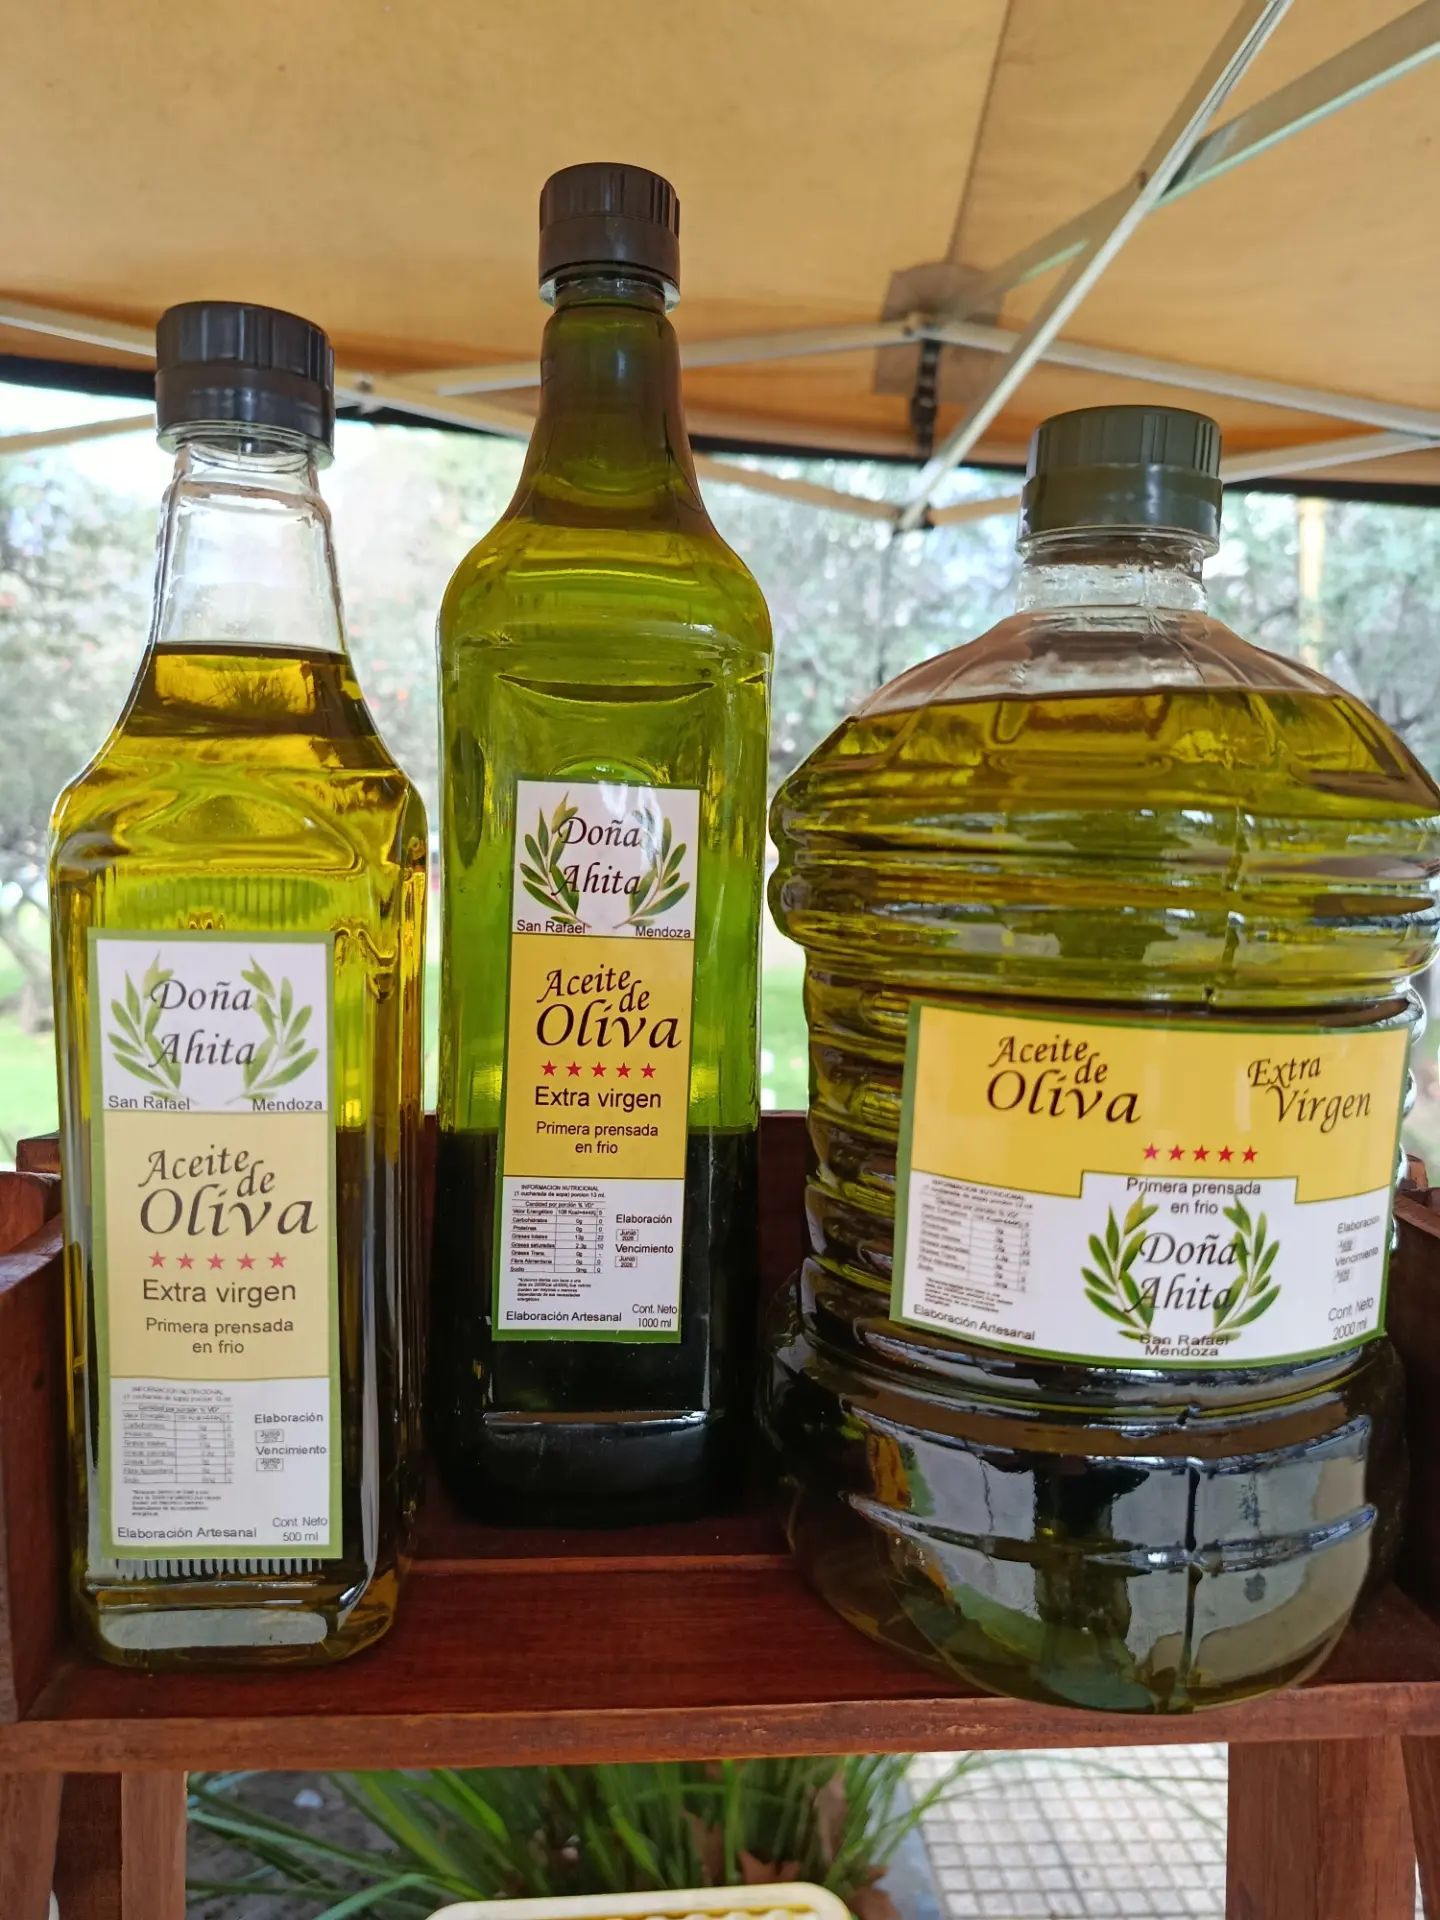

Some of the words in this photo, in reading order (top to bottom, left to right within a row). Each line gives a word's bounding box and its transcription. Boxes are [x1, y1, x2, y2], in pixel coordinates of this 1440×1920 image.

[557, 816, 641, 847] Doña
[551, 862, 642, 896] Ahita
[517, 919, 541, 932] San
[545, 921, 586, 934] Rafael
[635, 925, 691, 938] Mendoza
[536, 964, 631, 1003] Aceite
[150, 979, 252, 1011] Doña
[619, 980, 650, 1013] de
[536, 999, 682, 1049] Oliva
[148, 1029, 256, 1068] Ahita
[988, 1034, 1089, 1069] Aceite
[1074, 1052, 1108, 1085] de
[1247, 1056, 1321, 1089] Extra
[108, 1095, 138, 1109] San
[143, 1096, 190, 1110] Rafael
[252, 1098, 323, 1111] Mendoza
[535, 1086, 590, 1107] Extra
[597, 1089, 662, 1112] virgen
[987, 1068, 1142, 1124] Oliva
[1265, 1085, 1371, 1134] Virgen
[536, 1121, 590, 1135] Primera
[594, 1123, 658, 1138] prensada
[575, 1143, 592, 1154] en
[597, 1141, 618, 1154] frio
[137, 1144, 251, 1187] Aceite
[236, 1160, 275, 1198] de
[1126, 1177, 1188, 1194] Primera
[1192, 1178, 1261, 1197] prensada
[140, 1183, 318, 1236] Oliva
[1170, 1202, 1189, 1214] en
[1194, 1200, 1218, 1215] frio
[616, 1214, 672, 1224] Elaboración
[615, 1243, 674, 1253] Vencimiento
[1138, 1232, 1239, 1265] Doña
[143, 1279, 207, 1302] Extra
[216, 1282, 297, 1308] virgen
[1125, 1273, 1236, 1312] Ahita
[506, 1311, 569, 1321] Elaboración
[571, 1312, 622, 1322] Artesanal
[657, 1304, 677, 1314] Neto
[145, 1317, 209, 1334] Primera
[214, 1318, 294, 1337] prensada
[638, 1317, 658, 1328] 1000
[661, 1318, 672, 1328] ml
[913, 1303, 978, 1330] Elaboración
[979, 1321, 1036, 1341] Artesanal
[192, 1342, 212, 1354] en
[218, 1339, 245, 1354] frio
[1139, 1333, 1171, 1345] San
[1178, 1334, 1229, 1346] Rafael
[1145, 1345, 1219, 1357] Mendoza
[254, 1412, 324, 1424] Elaboración
[255, 1445, 327, 1456] Vencimiento
[302, 1516, 328, 1527] Neto
[117, 1526, 193, 1540] Elaboración
[196, 1526, 257, 1539] Artesanal
[282, 1531, 302, 1542] 500
[304, 1531, 319, 1542] ml
